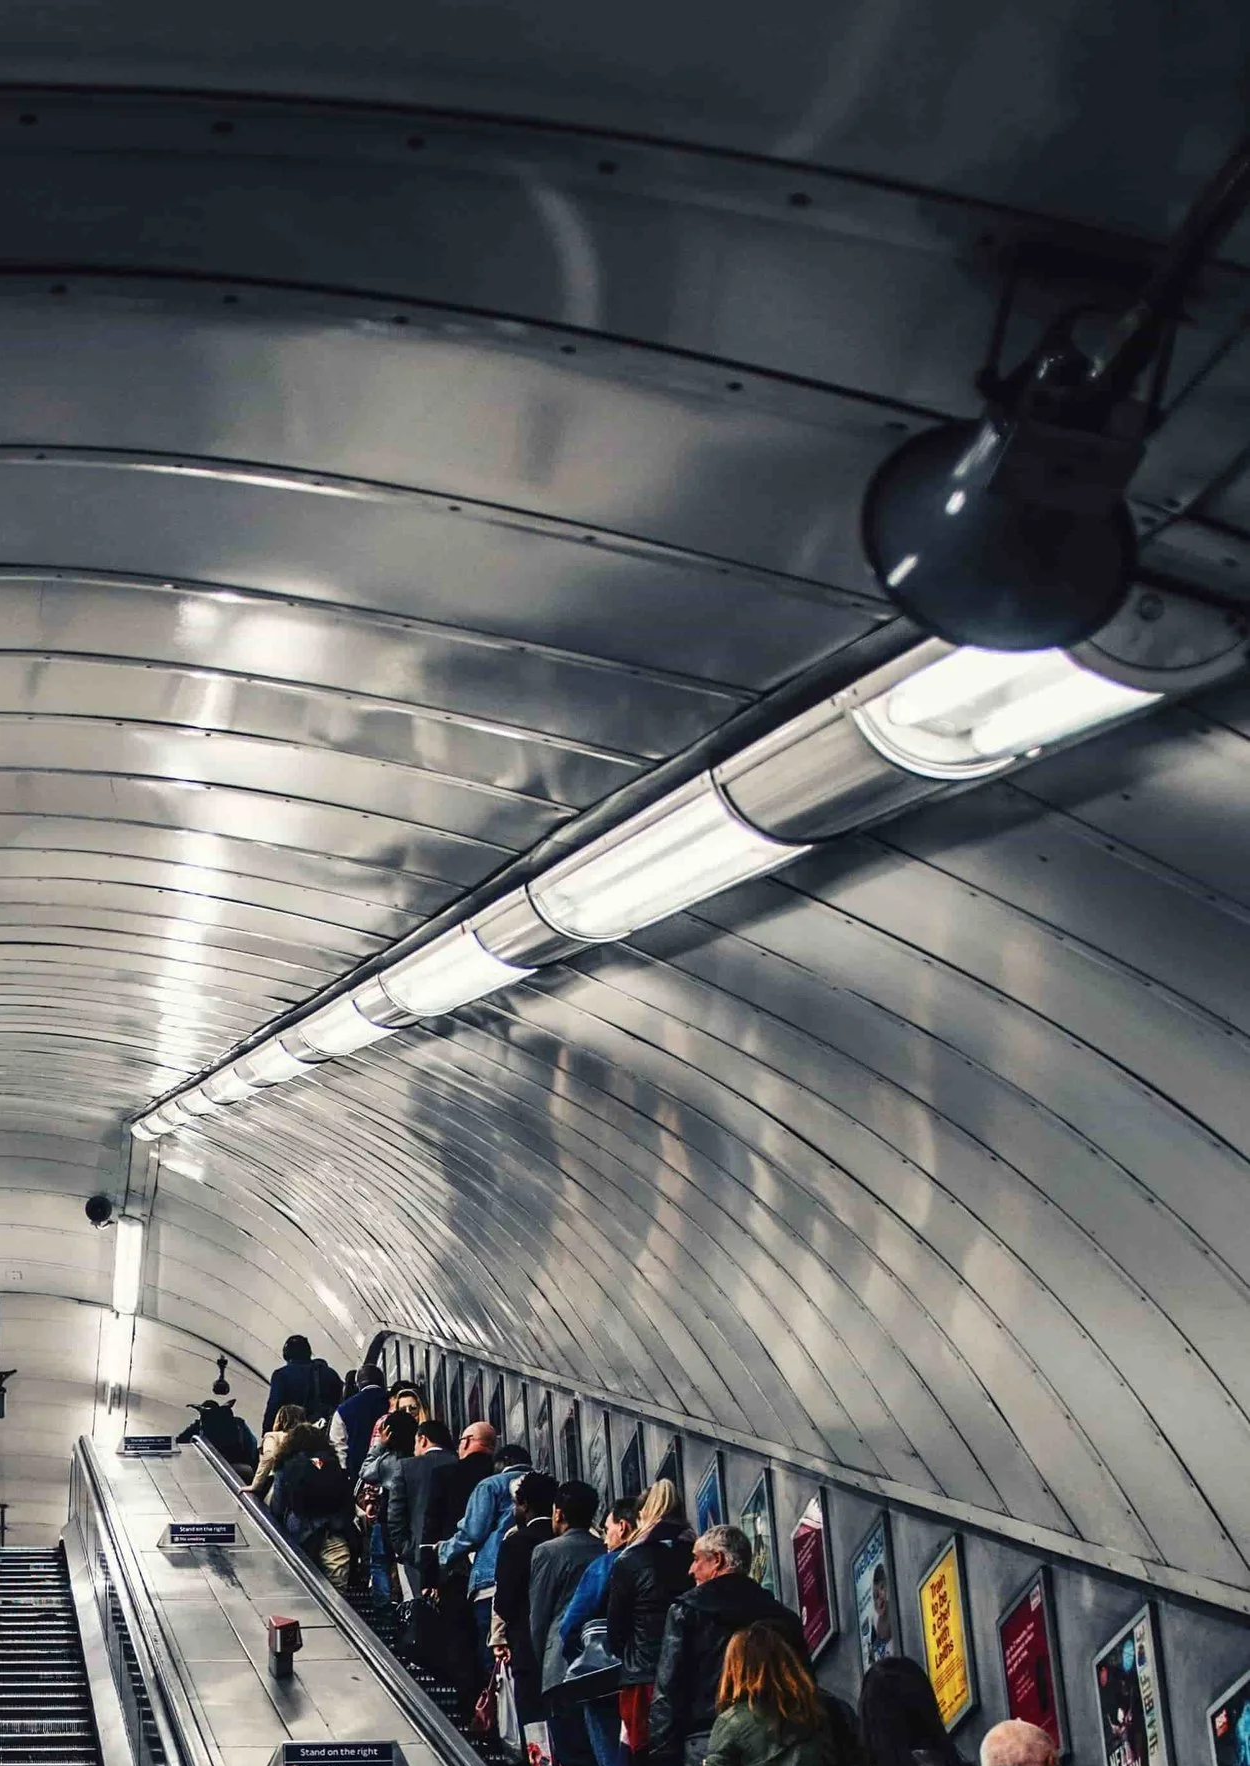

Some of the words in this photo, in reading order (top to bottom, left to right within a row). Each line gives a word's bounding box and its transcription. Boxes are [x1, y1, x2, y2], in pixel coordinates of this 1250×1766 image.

[930, 1574, 945, 1598] Train
[932, 1602, 939, 1617] to
[939, 1590, 947, 1608] be
[937, 1600, 951, 1629] chef
[936, 1626, 950, 1650] with
[300, 1747, 326, 1757] Stand
[340, 1747, 356, 1756] the
[357, 1747, 378, 1757] right
